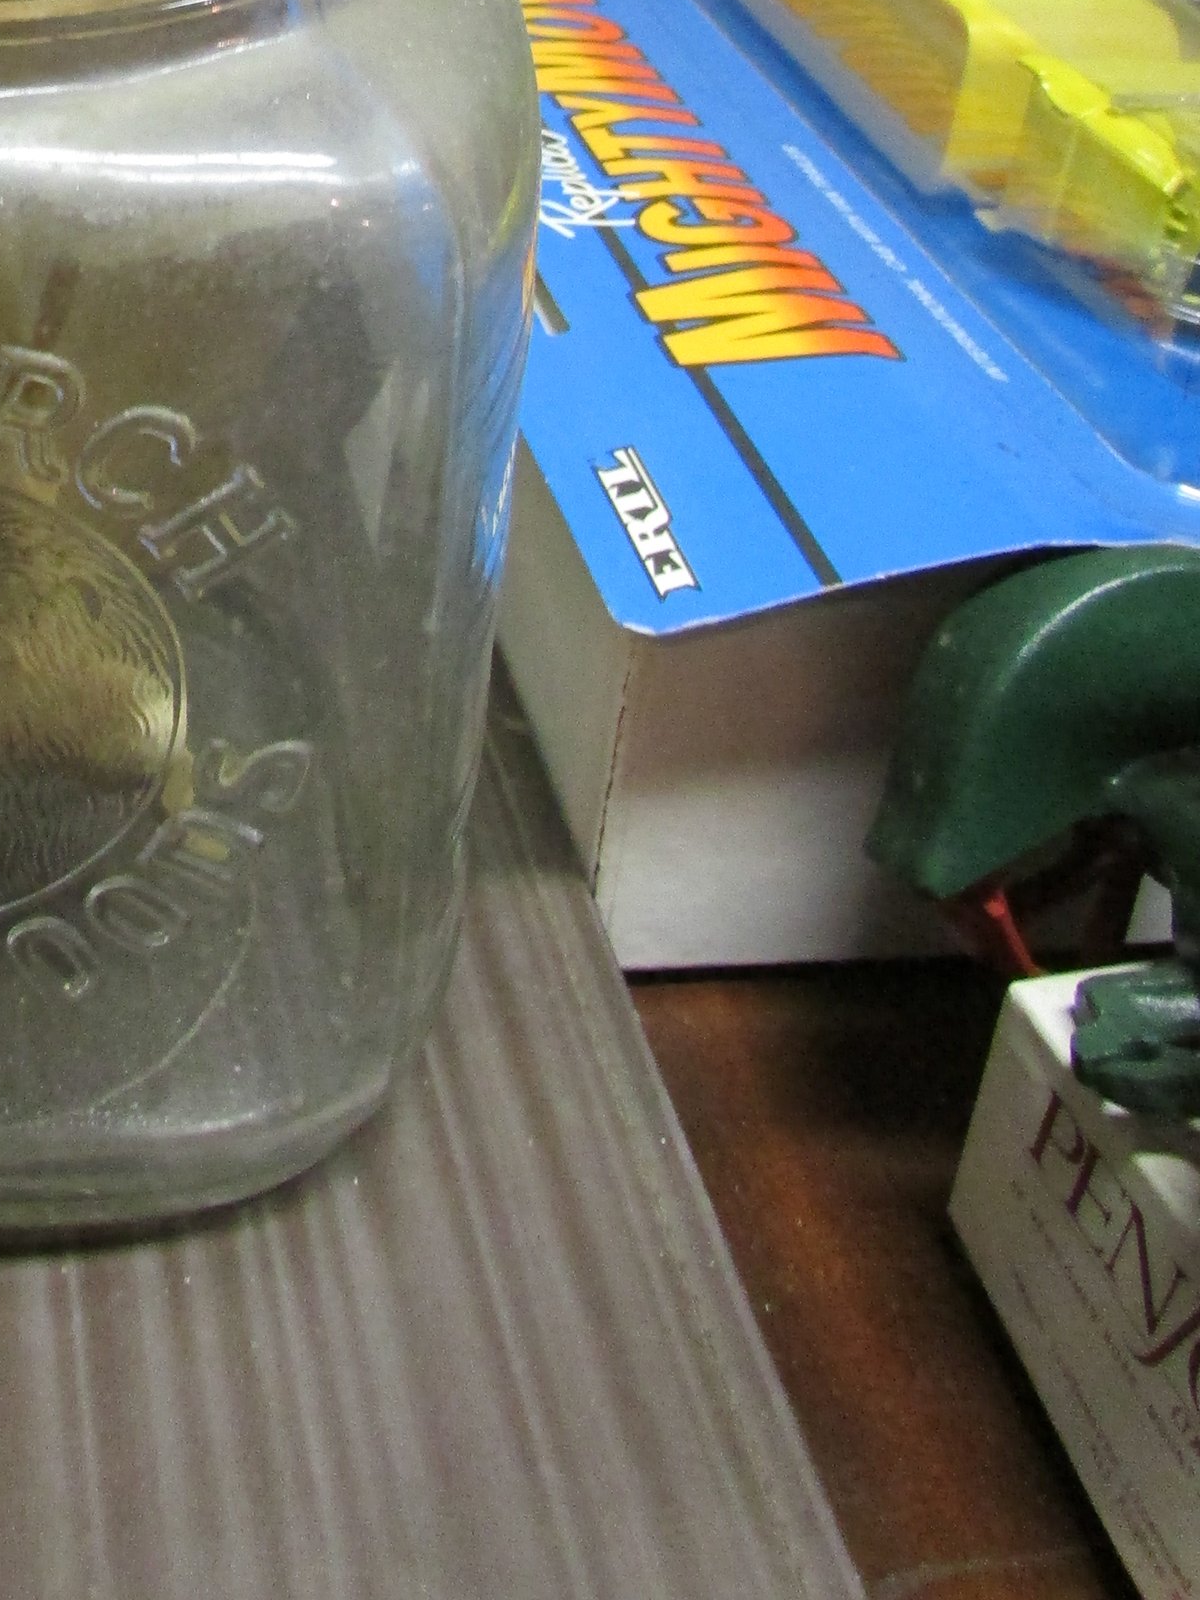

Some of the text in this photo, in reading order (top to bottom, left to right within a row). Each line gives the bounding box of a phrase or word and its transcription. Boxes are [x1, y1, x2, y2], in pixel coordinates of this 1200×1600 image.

[554, 91, 907, 367] MIGHTY
[594, 445, 702, 601] ERTL
[1028, 1088, 1200, 1412] PENJ
